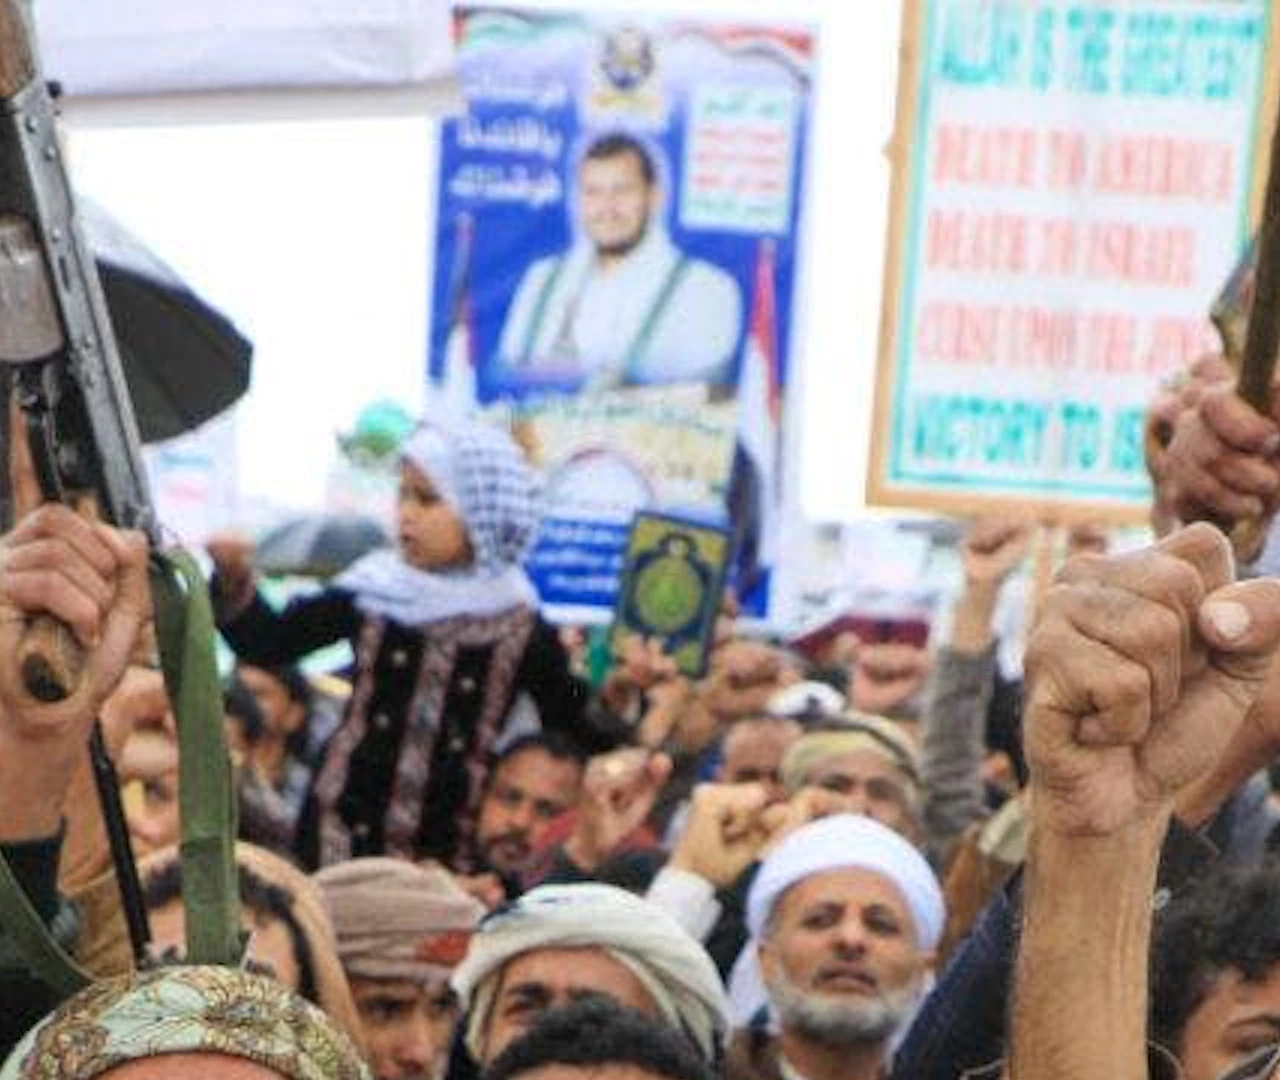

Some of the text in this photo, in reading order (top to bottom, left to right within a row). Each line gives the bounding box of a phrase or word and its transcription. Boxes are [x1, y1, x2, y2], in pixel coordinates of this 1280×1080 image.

[1066, 7, 1115, 94] THE
[933, 124, 1236, 207] DEATH TO AMERICA
[926, 208, 1198, 288] DEATH TO ISRAEL
[1056, 402, 1101, 470] TO
